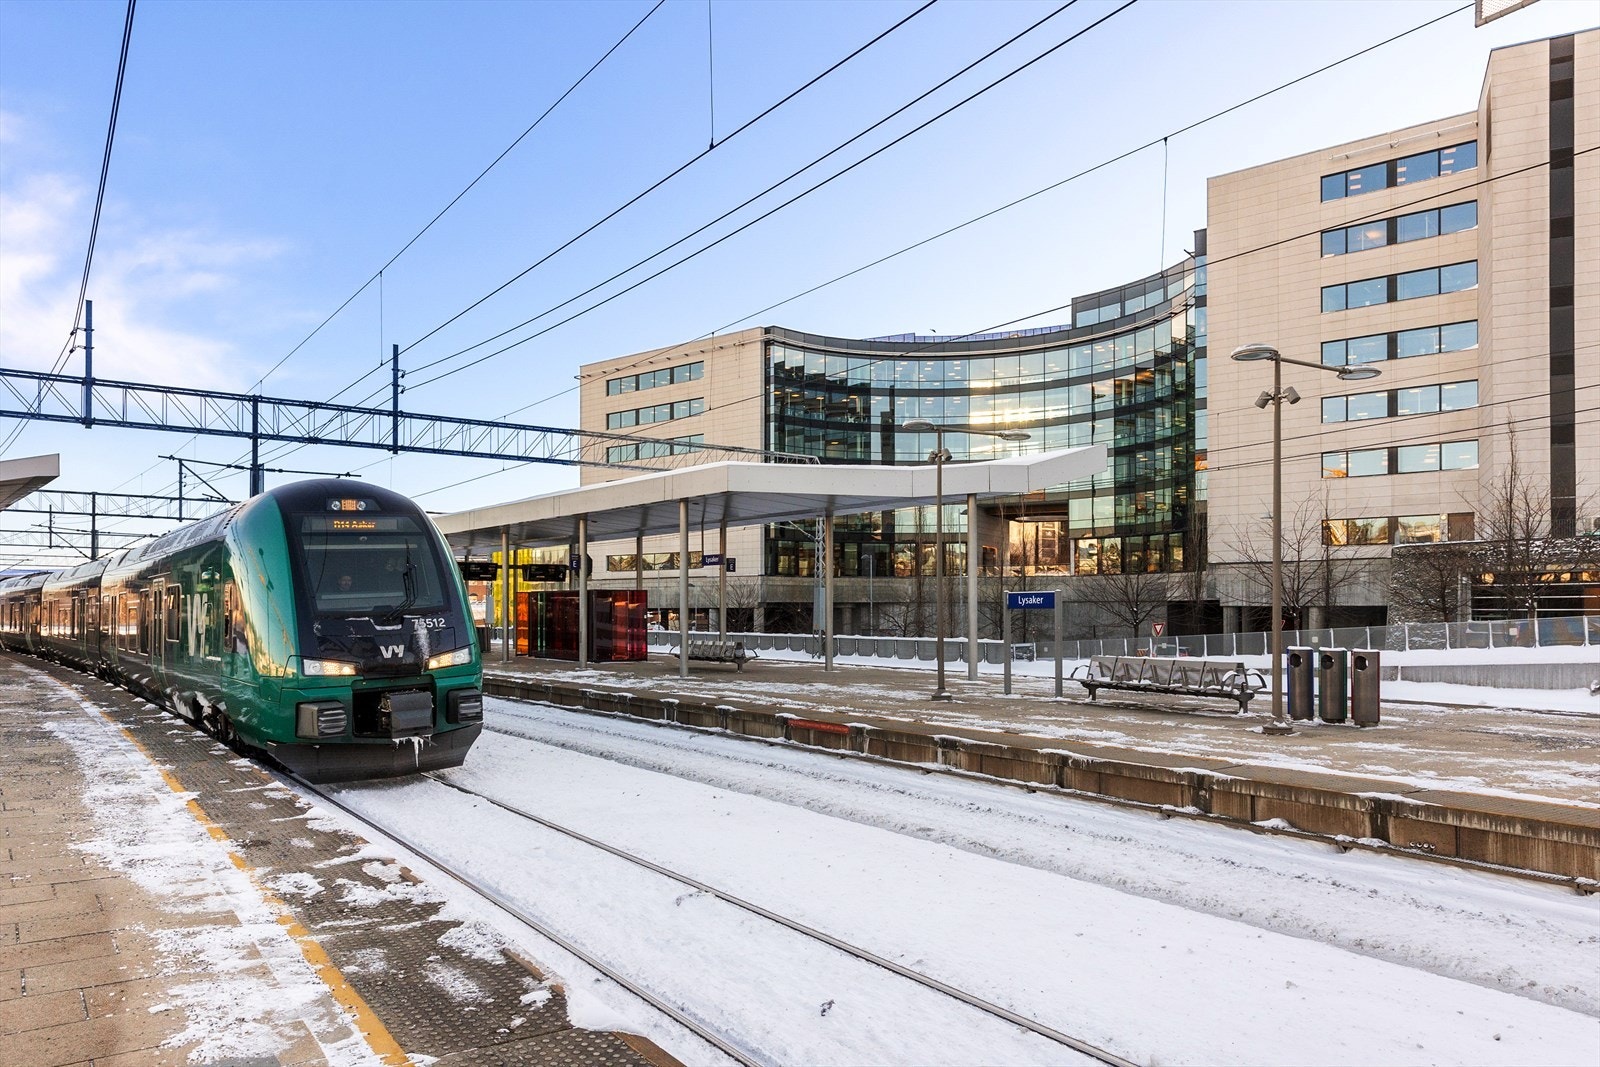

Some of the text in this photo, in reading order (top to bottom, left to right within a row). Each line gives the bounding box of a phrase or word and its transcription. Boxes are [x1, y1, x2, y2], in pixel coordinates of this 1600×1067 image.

[705, 556, 719, 564] Lysaker
[1018, 595, 1044, 606] Lysaker
[411, 618, 446, 629] 75512
